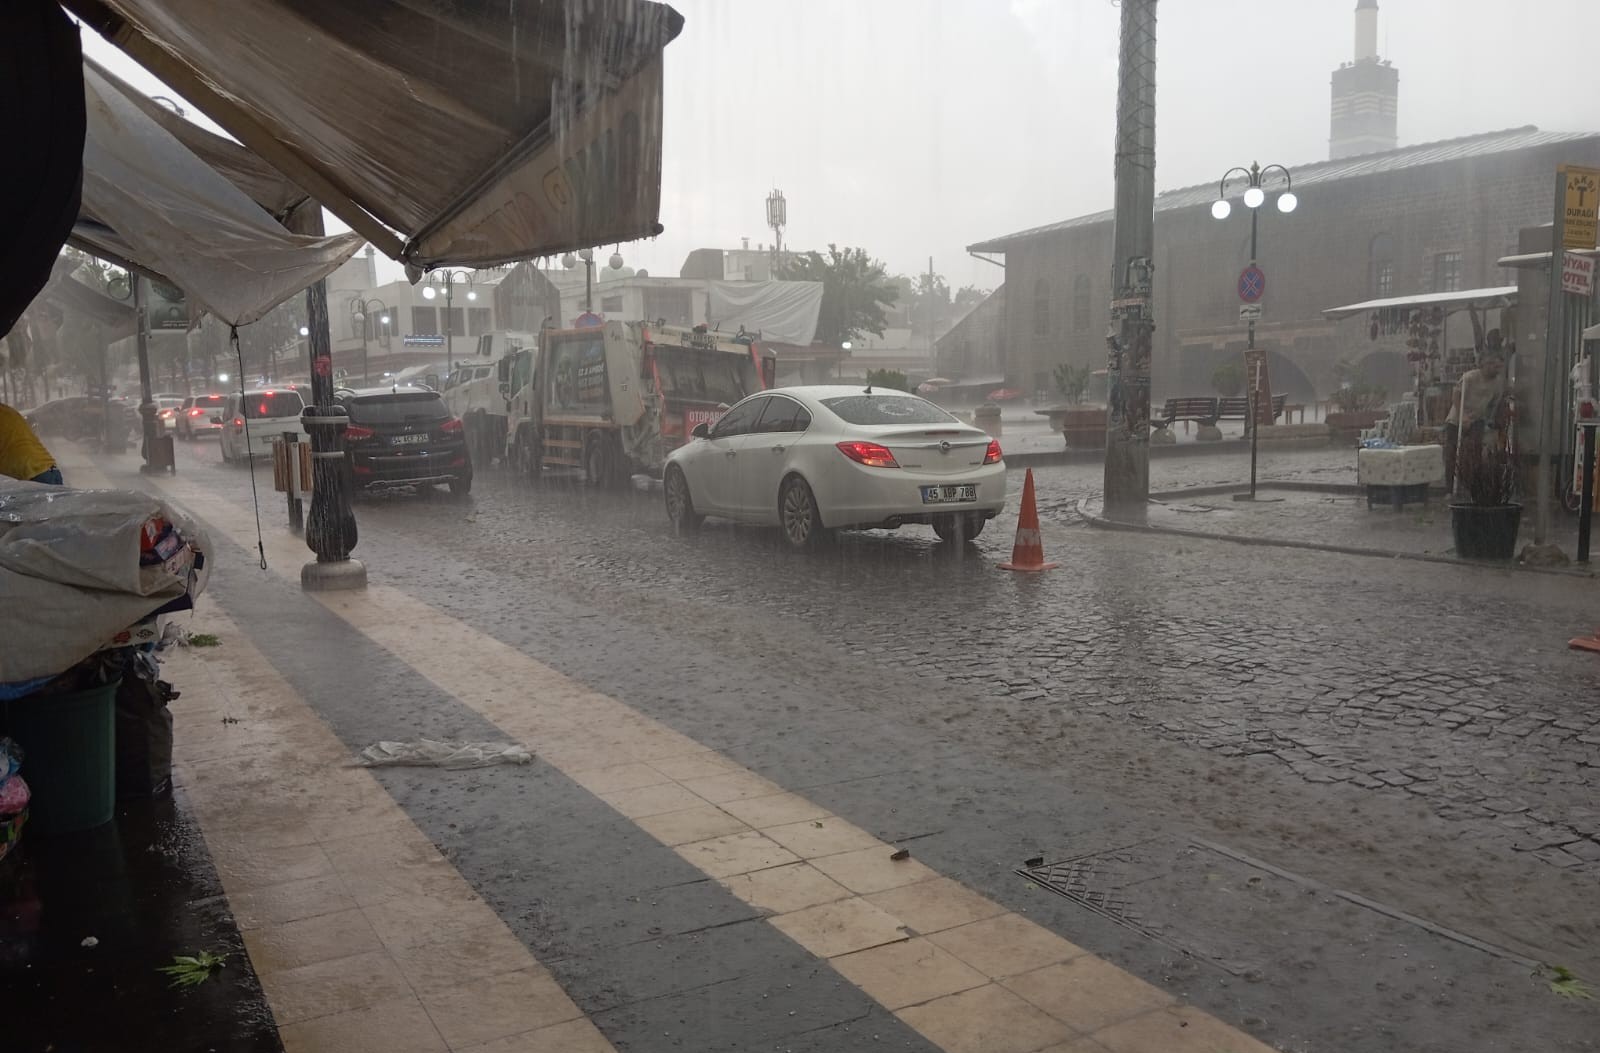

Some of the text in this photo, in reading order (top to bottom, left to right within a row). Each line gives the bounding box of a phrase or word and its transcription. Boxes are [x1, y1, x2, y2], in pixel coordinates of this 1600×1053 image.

[1564, 271, 1589, 287] OTEL
[689, 411, 722, 424] OTOPAR
[928, 488, 938, 499] 45
